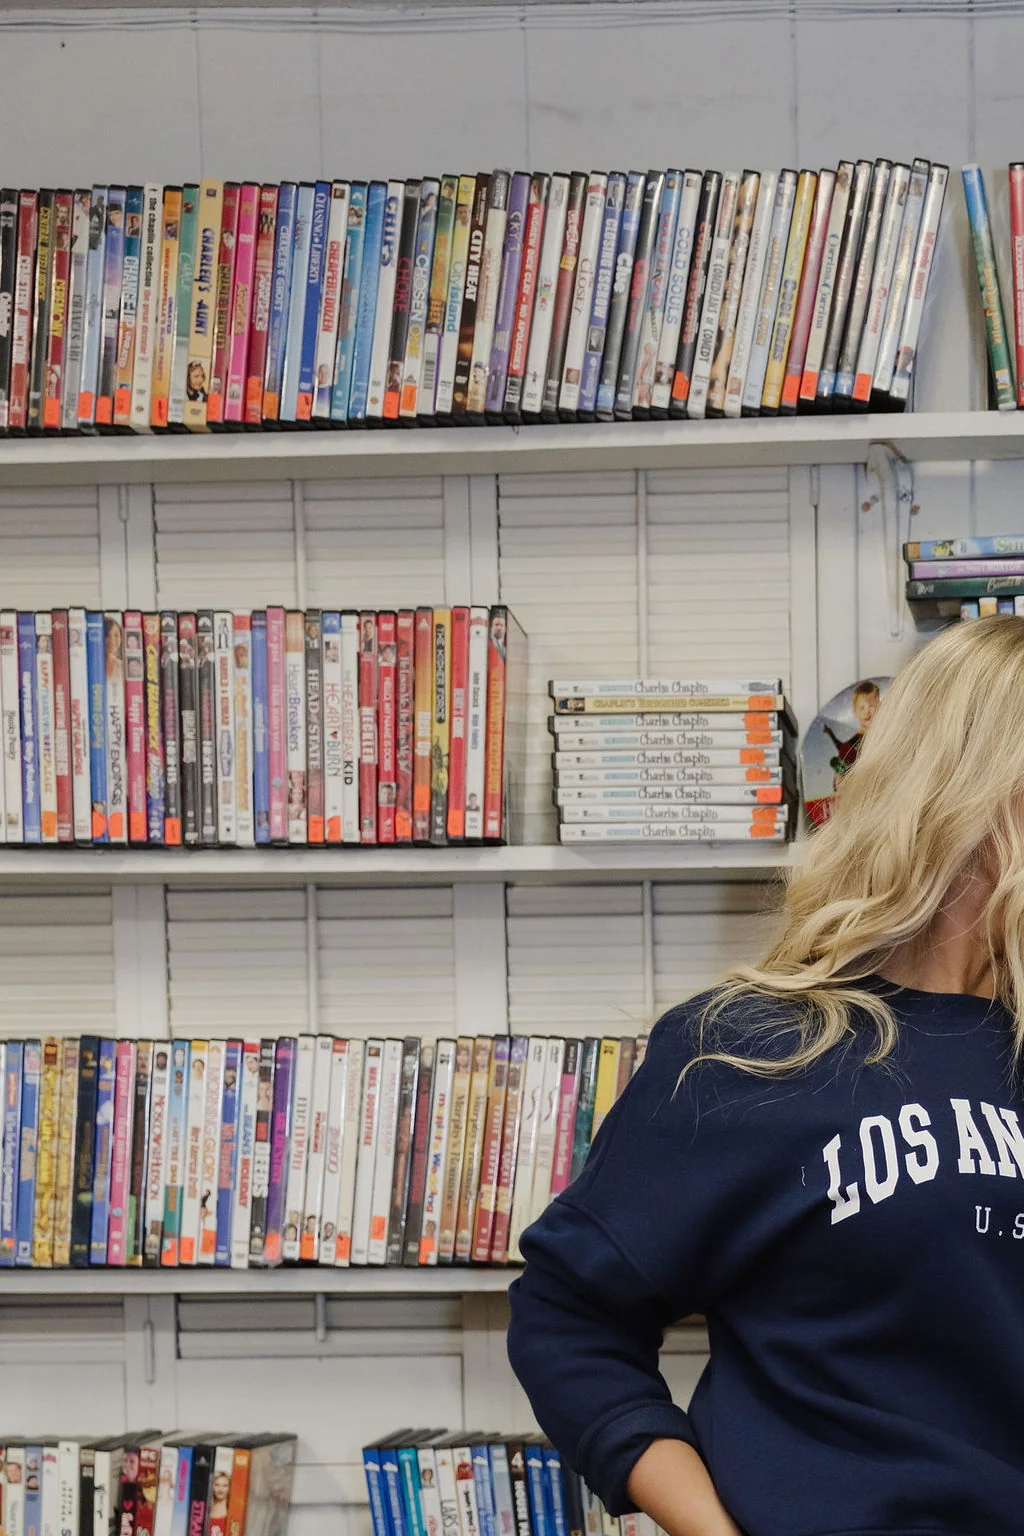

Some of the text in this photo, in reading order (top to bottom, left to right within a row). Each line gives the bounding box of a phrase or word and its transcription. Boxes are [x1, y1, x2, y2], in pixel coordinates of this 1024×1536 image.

[309, 193, 326, 284] CHASING LIBERTY
[381, 196, 399, 266] CHIPS
[465, 230, 483, 301] CITY HEAT
[509, 211, 523, 239] CKY
[593, 218, 616, 318] CLOSING ESCROW
[195, 228, 214, 337] CHARLEY'S AUNT
[322, 241, 340, 333] CHEAPER DOZEN
[394, 257, 412, 311] CHOKE
[409, 254, 429, 359] CHOSEN ONE
[666, 228, 691, 325] COLD SOULS
[822, 1103, 940, 1224] LOS
[515, 1481, 527, 1519] HOUSE
